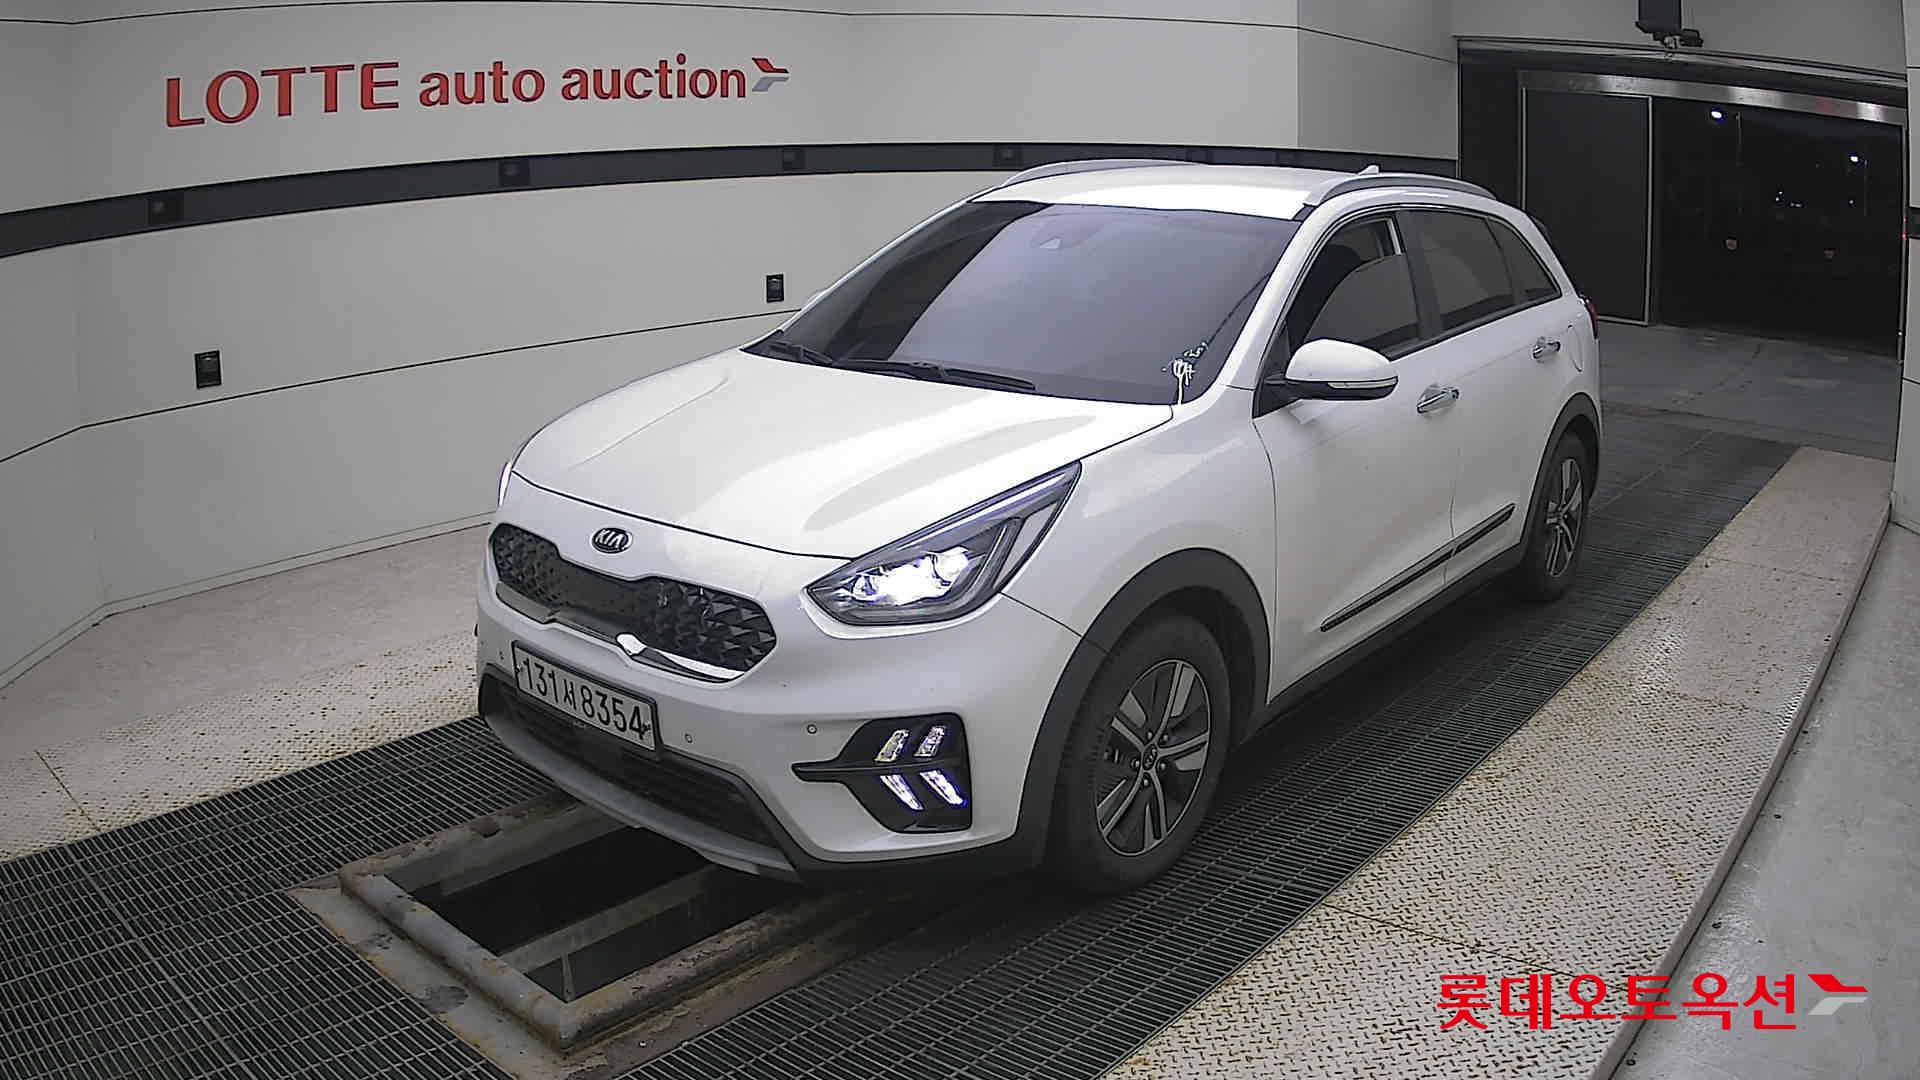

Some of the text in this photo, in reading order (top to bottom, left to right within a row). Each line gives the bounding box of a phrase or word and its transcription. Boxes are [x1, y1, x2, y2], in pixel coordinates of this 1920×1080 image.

[165, 53, 747, 128] LOTTE auto auction
[595, 529, 624, 548] KIA
